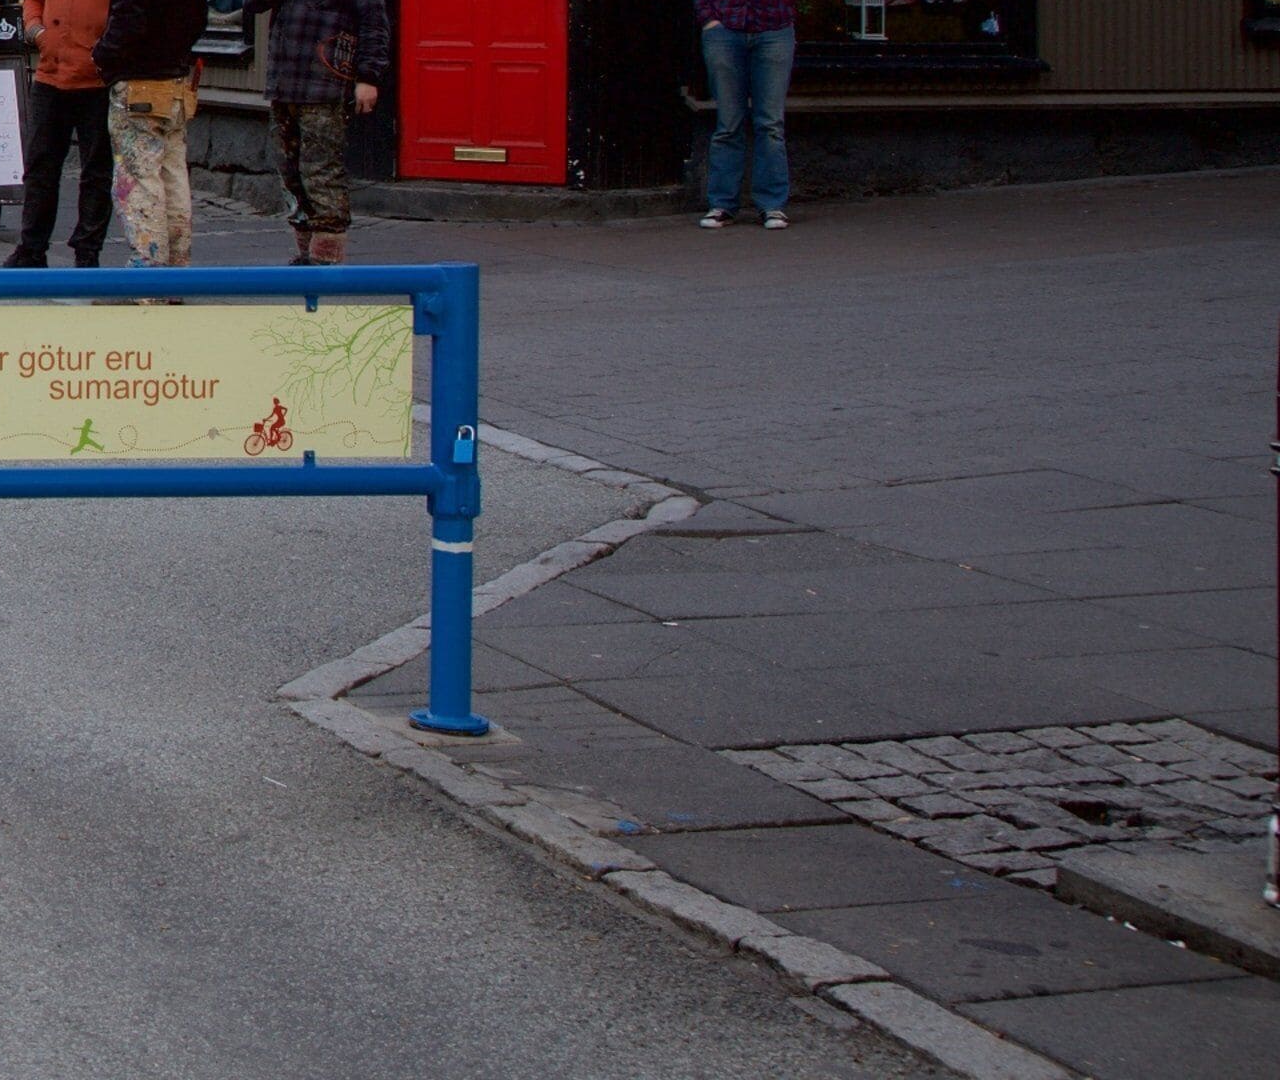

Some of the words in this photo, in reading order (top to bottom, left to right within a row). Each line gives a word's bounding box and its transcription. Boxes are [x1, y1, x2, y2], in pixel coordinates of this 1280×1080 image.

[19, 344, 95, 378] götur
[105, 349, 153, 371] eru
[49, 373, 220, 406] sumargötur
